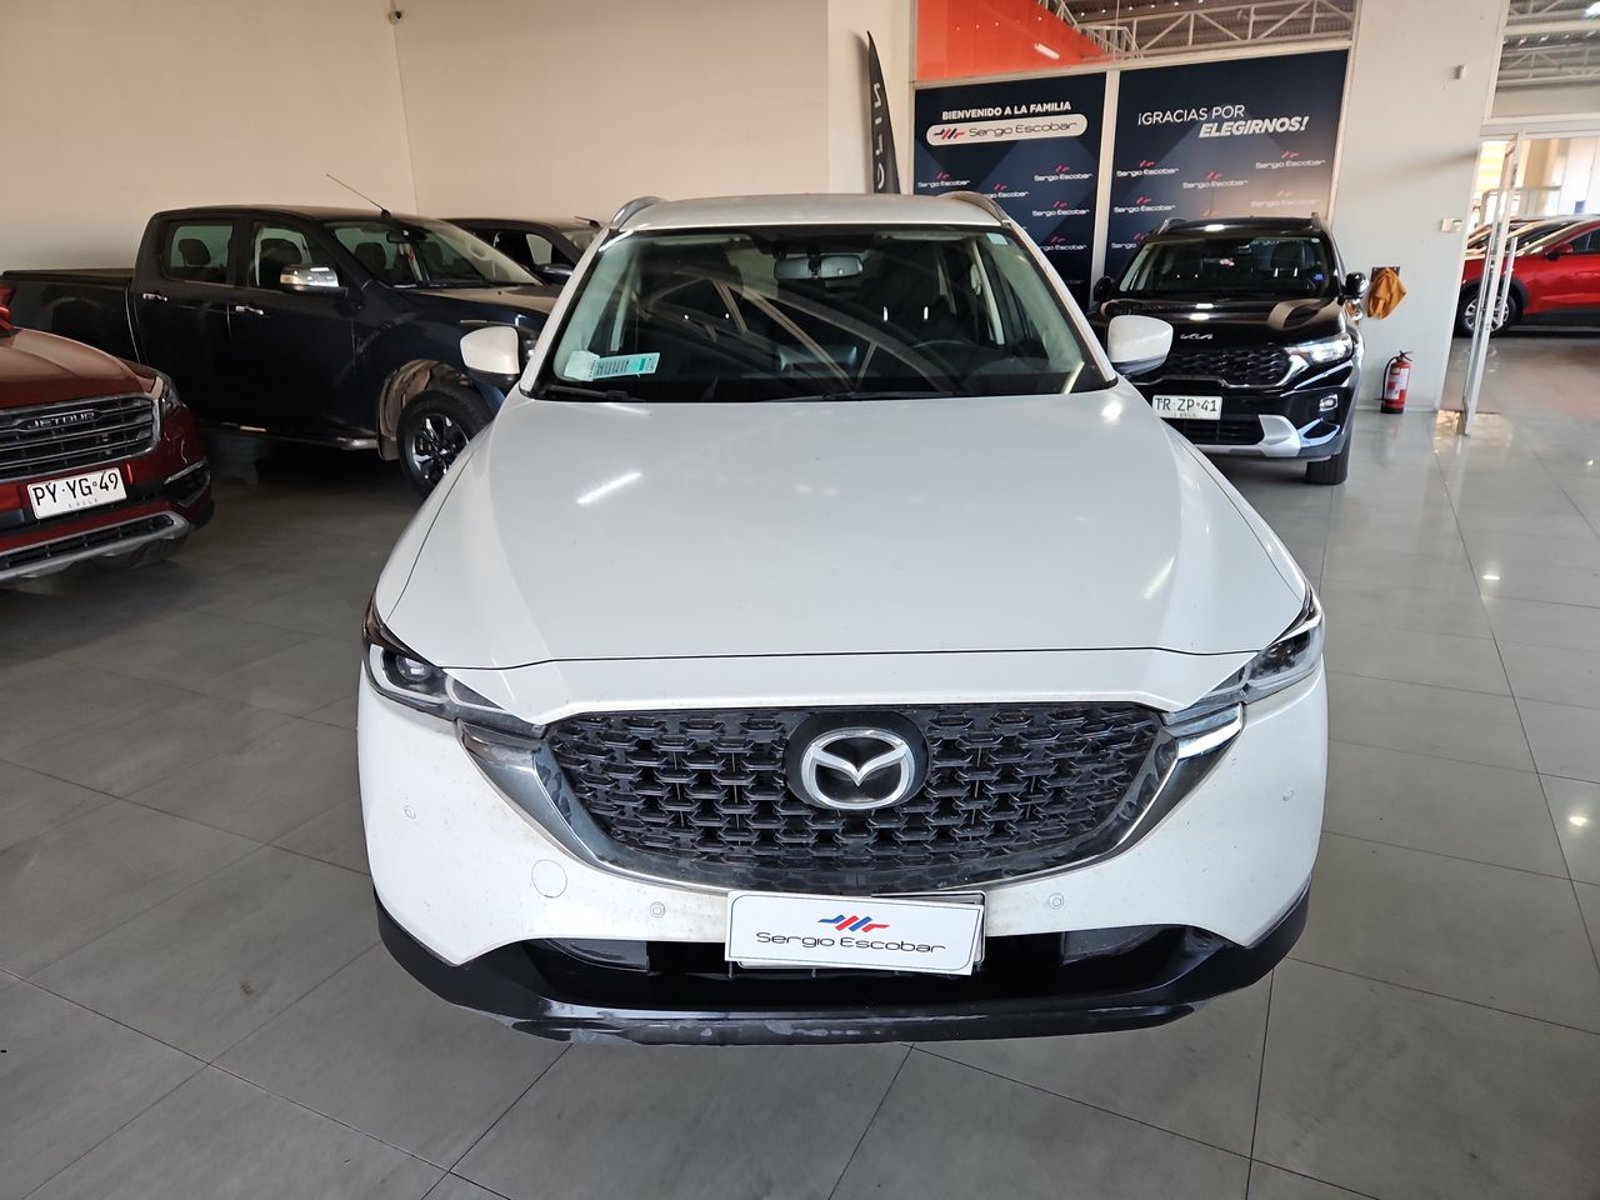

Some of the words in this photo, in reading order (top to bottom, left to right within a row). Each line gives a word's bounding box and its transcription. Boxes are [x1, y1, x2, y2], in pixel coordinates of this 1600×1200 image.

[942, 106, 1001, 120] BIENVENIDO
[1004, 106, 1012, 116] A
[1014, 104, 1027, 115] LA
[1030, 101, 1071, 113] FAMILIA
[1138, 107, 1208, 126] ¡GRACIAS
[1212, 104, 1245, 119] POR
[1015, 121, 1078, 134] Escobar
[1199, 116, 1309, 138] ELEGIRNOS!
[756, 932, 835, 948] Sergio
[839, 937, 946, 954] Escobar
